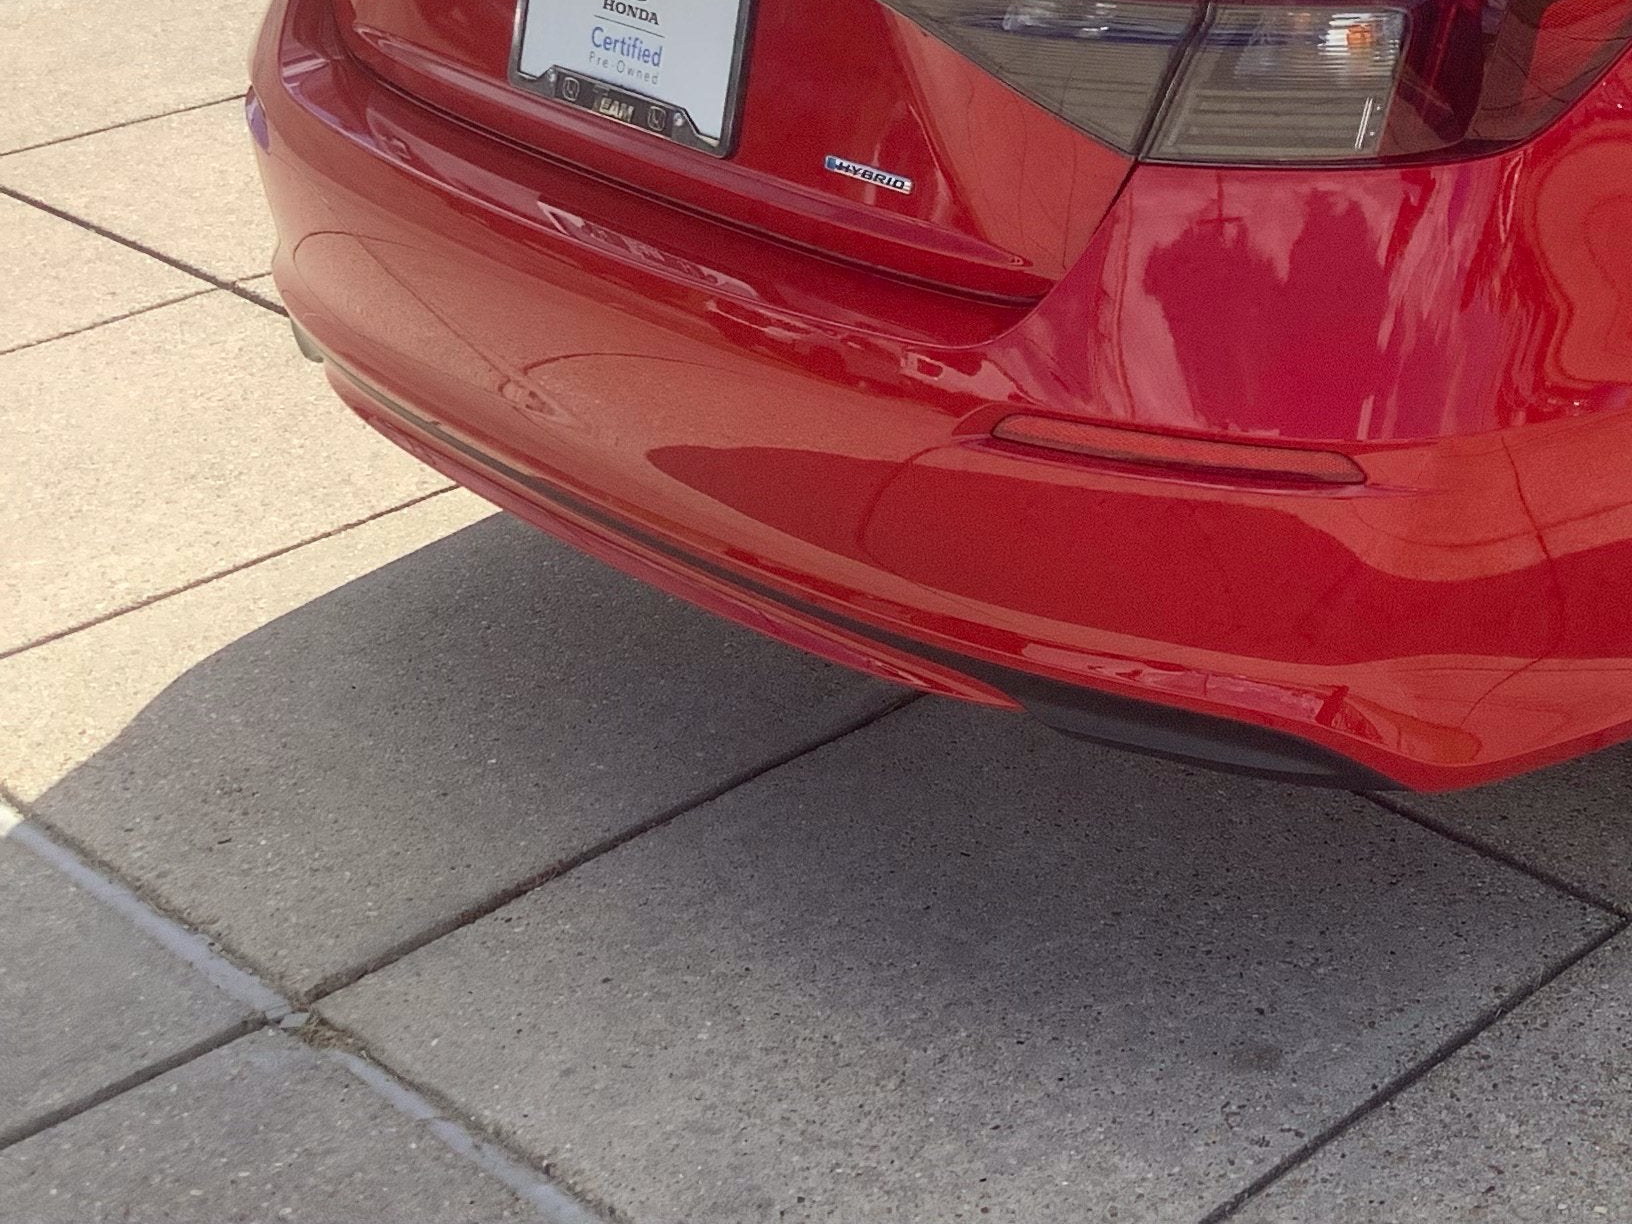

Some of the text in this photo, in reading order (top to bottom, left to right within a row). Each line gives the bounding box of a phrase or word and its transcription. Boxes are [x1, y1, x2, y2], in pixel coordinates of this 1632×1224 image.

[591, 26, 663, 67] Certified
[589, 50, 660, 85] Pre-Owned
[592, 83, 635, 123] TEAM
